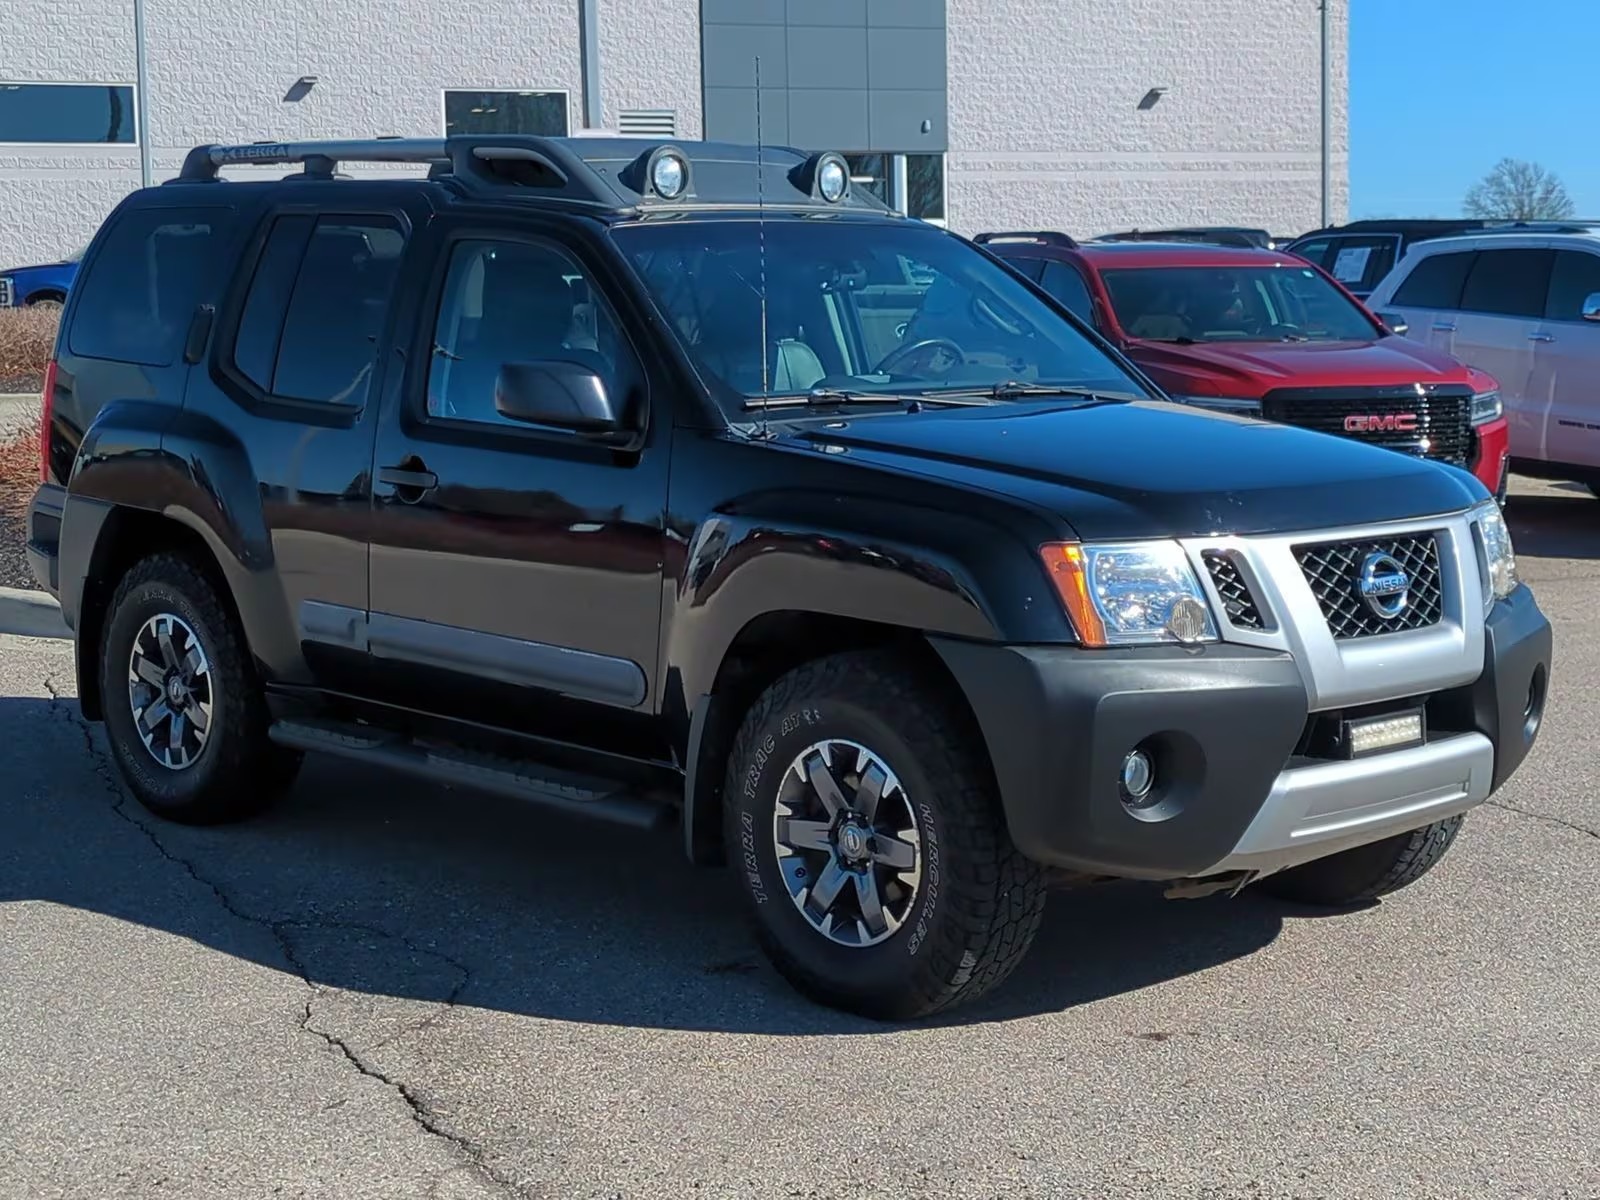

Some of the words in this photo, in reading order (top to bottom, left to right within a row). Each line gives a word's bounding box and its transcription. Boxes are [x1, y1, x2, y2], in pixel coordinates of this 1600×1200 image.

[222, 146, 288, 160] XTERRA
[1344, 413, 1418, 432] GMC
[1371, 577, 1407, 591] NISSAN
[744, 735, 776, 799] TRAC
[741, 812, 768, 903] TERRA
[907, 803, 939, 955] HERCULES
